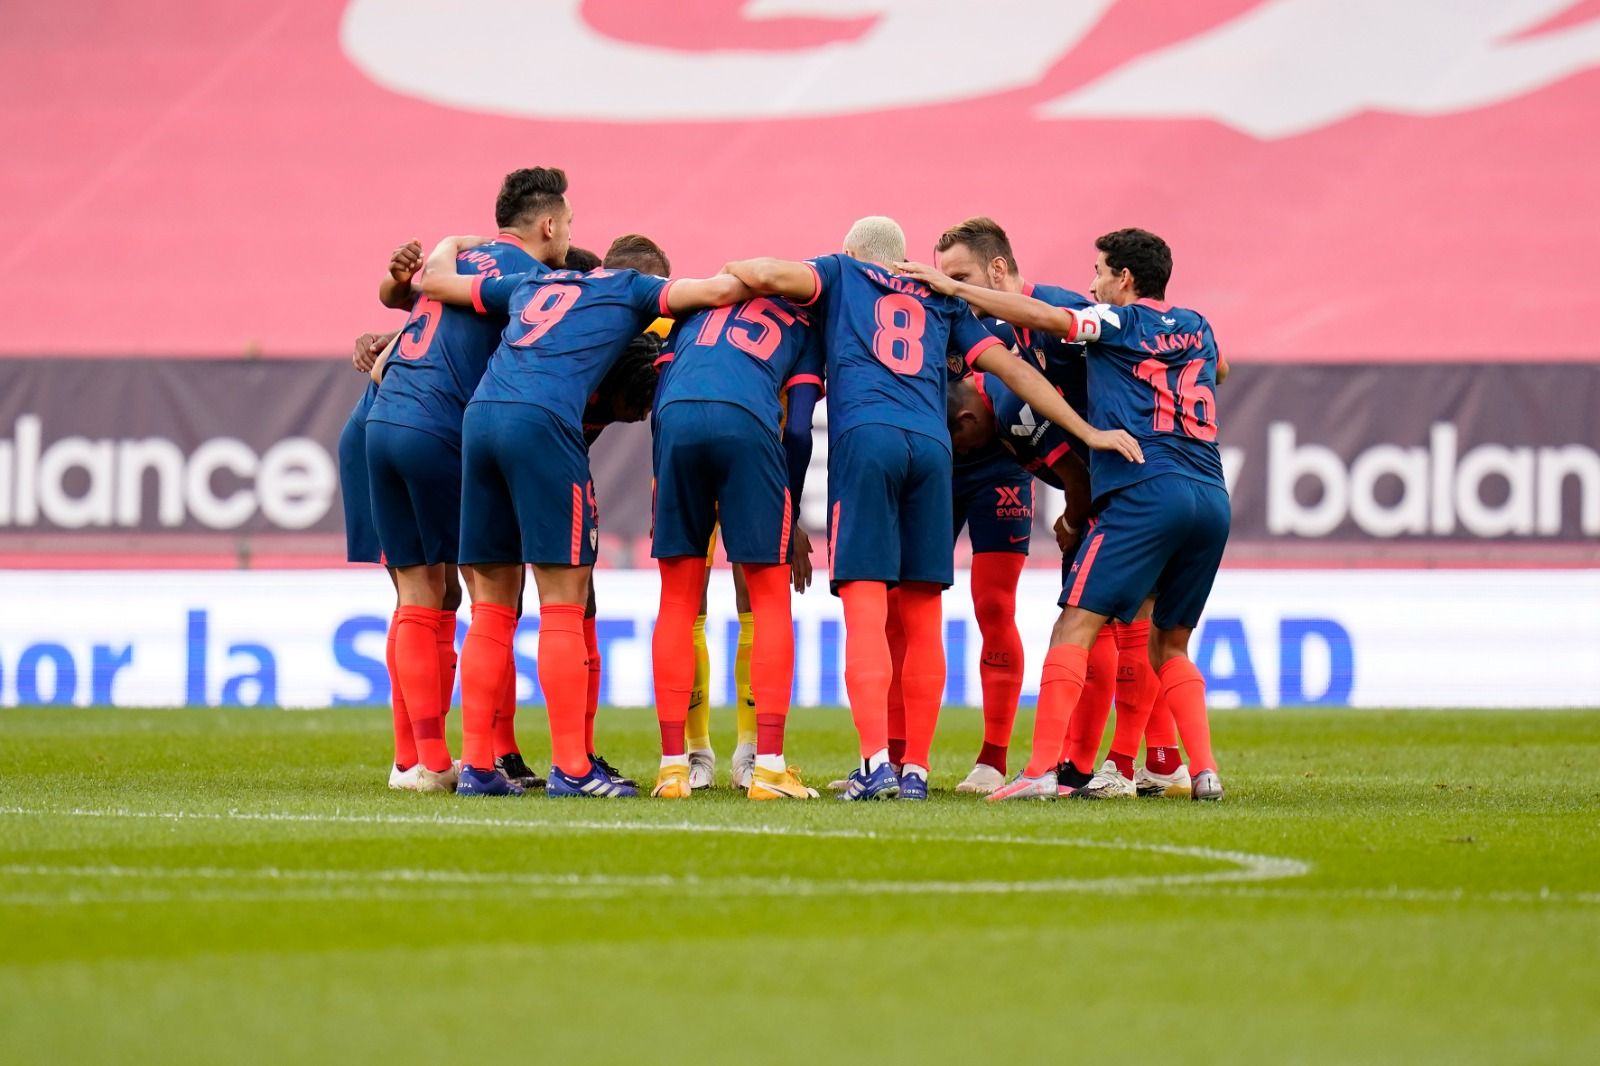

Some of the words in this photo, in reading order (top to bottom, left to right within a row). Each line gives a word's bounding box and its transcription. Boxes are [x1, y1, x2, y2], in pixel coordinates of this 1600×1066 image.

[398, 295, 442, 360] 5
[510, 283, 582, 346] 9
[695, 296, 795, 361] 15
[872, 293, 926, 376] 8
[1132, 357, 1218, 443] 16
[0, 413, 337, 530] lance
[186, 608, 279, 705] la
